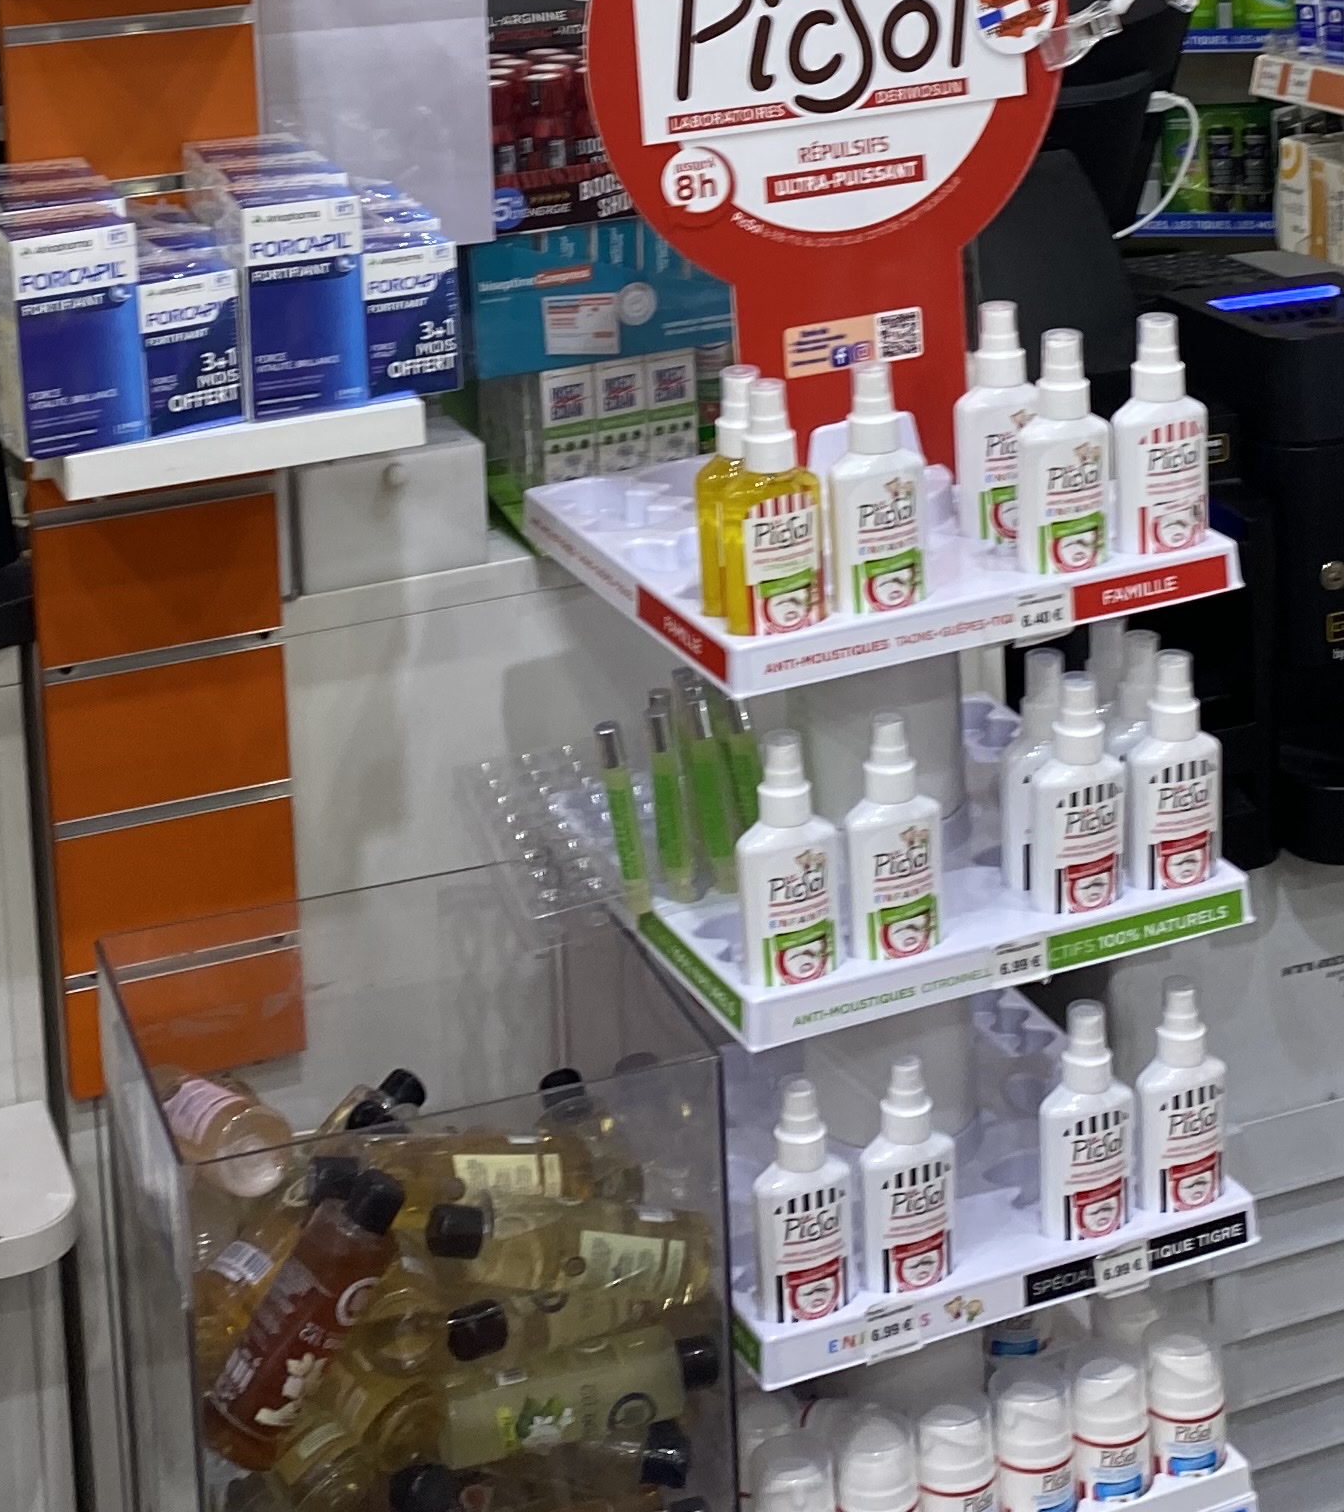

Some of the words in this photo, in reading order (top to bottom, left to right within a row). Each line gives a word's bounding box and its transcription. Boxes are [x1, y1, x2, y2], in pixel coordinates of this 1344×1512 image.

[671, 104, 786, 131] LABORATOIRES
[874, 80, 964, 105] DERMOSUN
[798, 136, 889, 163] RÉPULSIFS
[675, 173, 717, 201] 8h
[774, 161, 918, 196] ULTRA-PUISSANT
[249, 232, 353, 260] FORCAPIL
[19, 260, 127, 293] FORCAPIL
[252, 262, 333, 283] FORTIFIANT
[21, 292, 105, 317] FORTIFIANT
[419, 318, 456, 340] 3+1
[200, 347, 238, 372] 3+1
[416, 338, 458, 357] MOIS
[197, 369, 240, 389] MOIS
[387, 351, 459, 379] OFFERT
[167, 383, 240, 413] OFFERT
[1102, 576, 1178, 605] FAMILLE
[764, 637, 890, 676] ANTI-MOUSTIQUES
[1096, 928, 1139, 949] 100%
[1143, 905, 1230, 937] NATURELS
[792, 986, 917, 1028] ANTI-MOUSTIQUES
[1168, 1103, 1218, 1136] PicSol
[1072, 1127, 1125, 1162] PicSol
[890, 1178, 946, 1215] PicSol
[783, 1203, 841, 1242] PicSol
[1197, 1222, 1244, 1246] TIGRE
[1102, 1263, 1131, 1280] 6.99
[1132, 1258, 1142, 1271] €
[870, 1324, 900, 1342] 6.99
[902, 1320, 913, 1332] €
